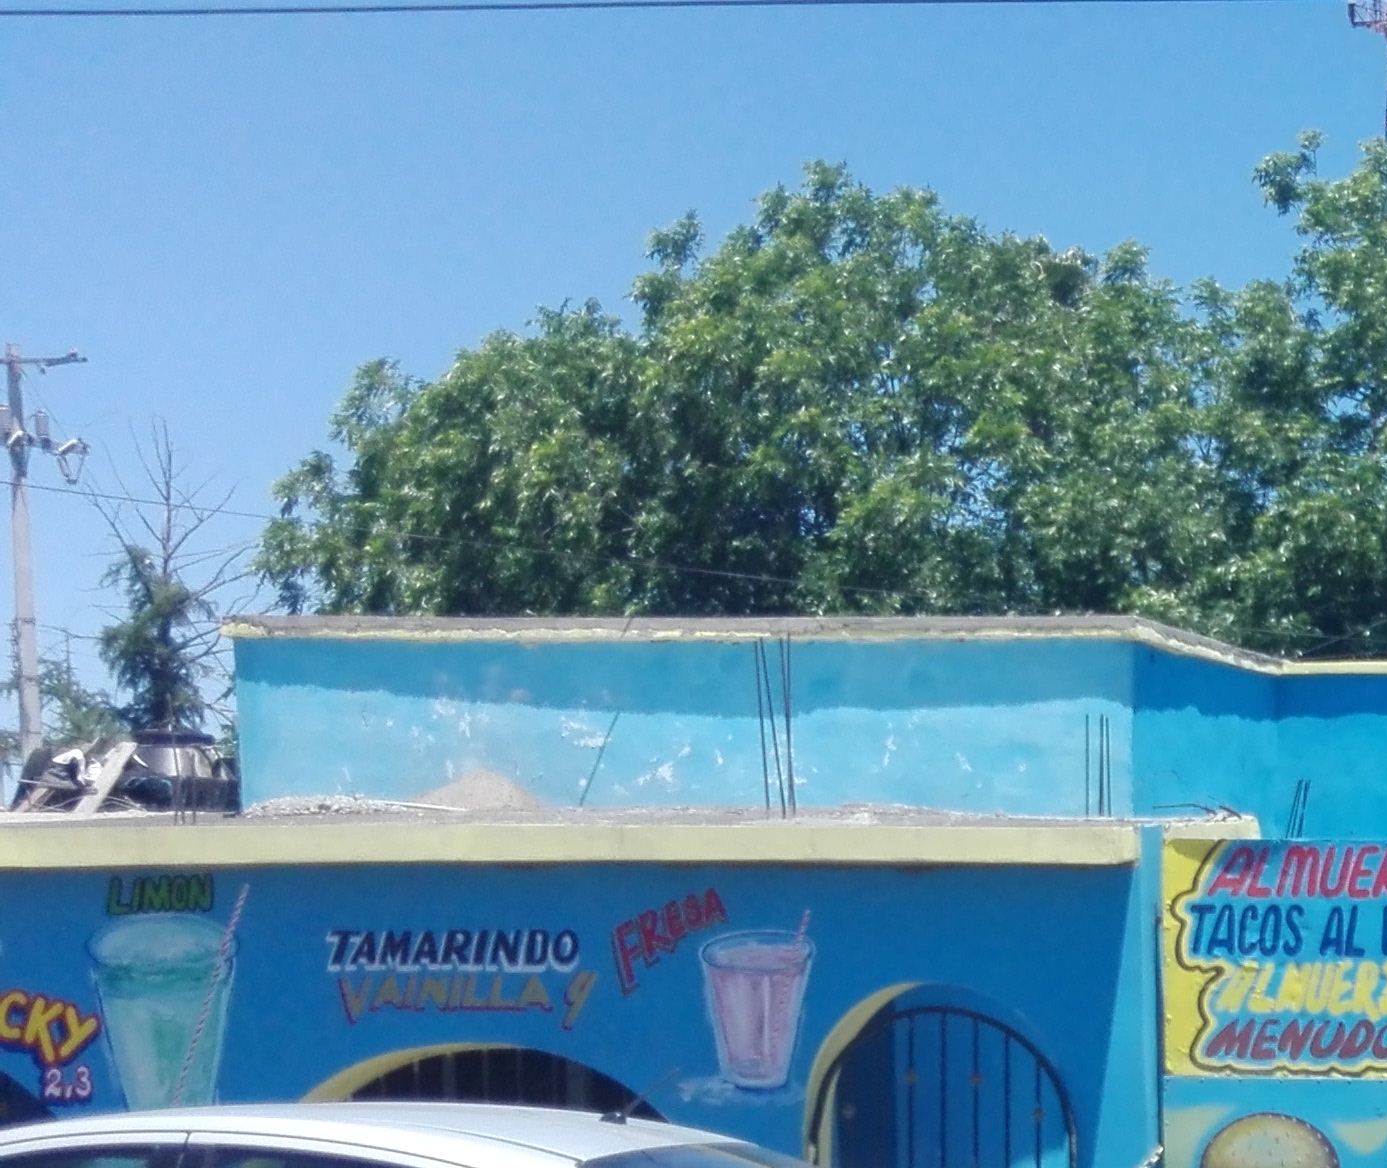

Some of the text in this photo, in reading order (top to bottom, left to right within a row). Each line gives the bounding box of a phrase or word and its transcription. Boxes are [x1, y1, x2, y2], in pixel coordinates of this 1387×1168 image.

[107, 873, 214, 915] LIMON
[326, 929, 579, 973] TAMARINDO
[610, 887, 727, 997] FRESA
[1190, 904, 1305, 957] TACOS
[1319, 905, 1365, 957] AL
[338, 974, 553, 1025] VAINILLA
[43, 1066, 93, 1099] 2,3
